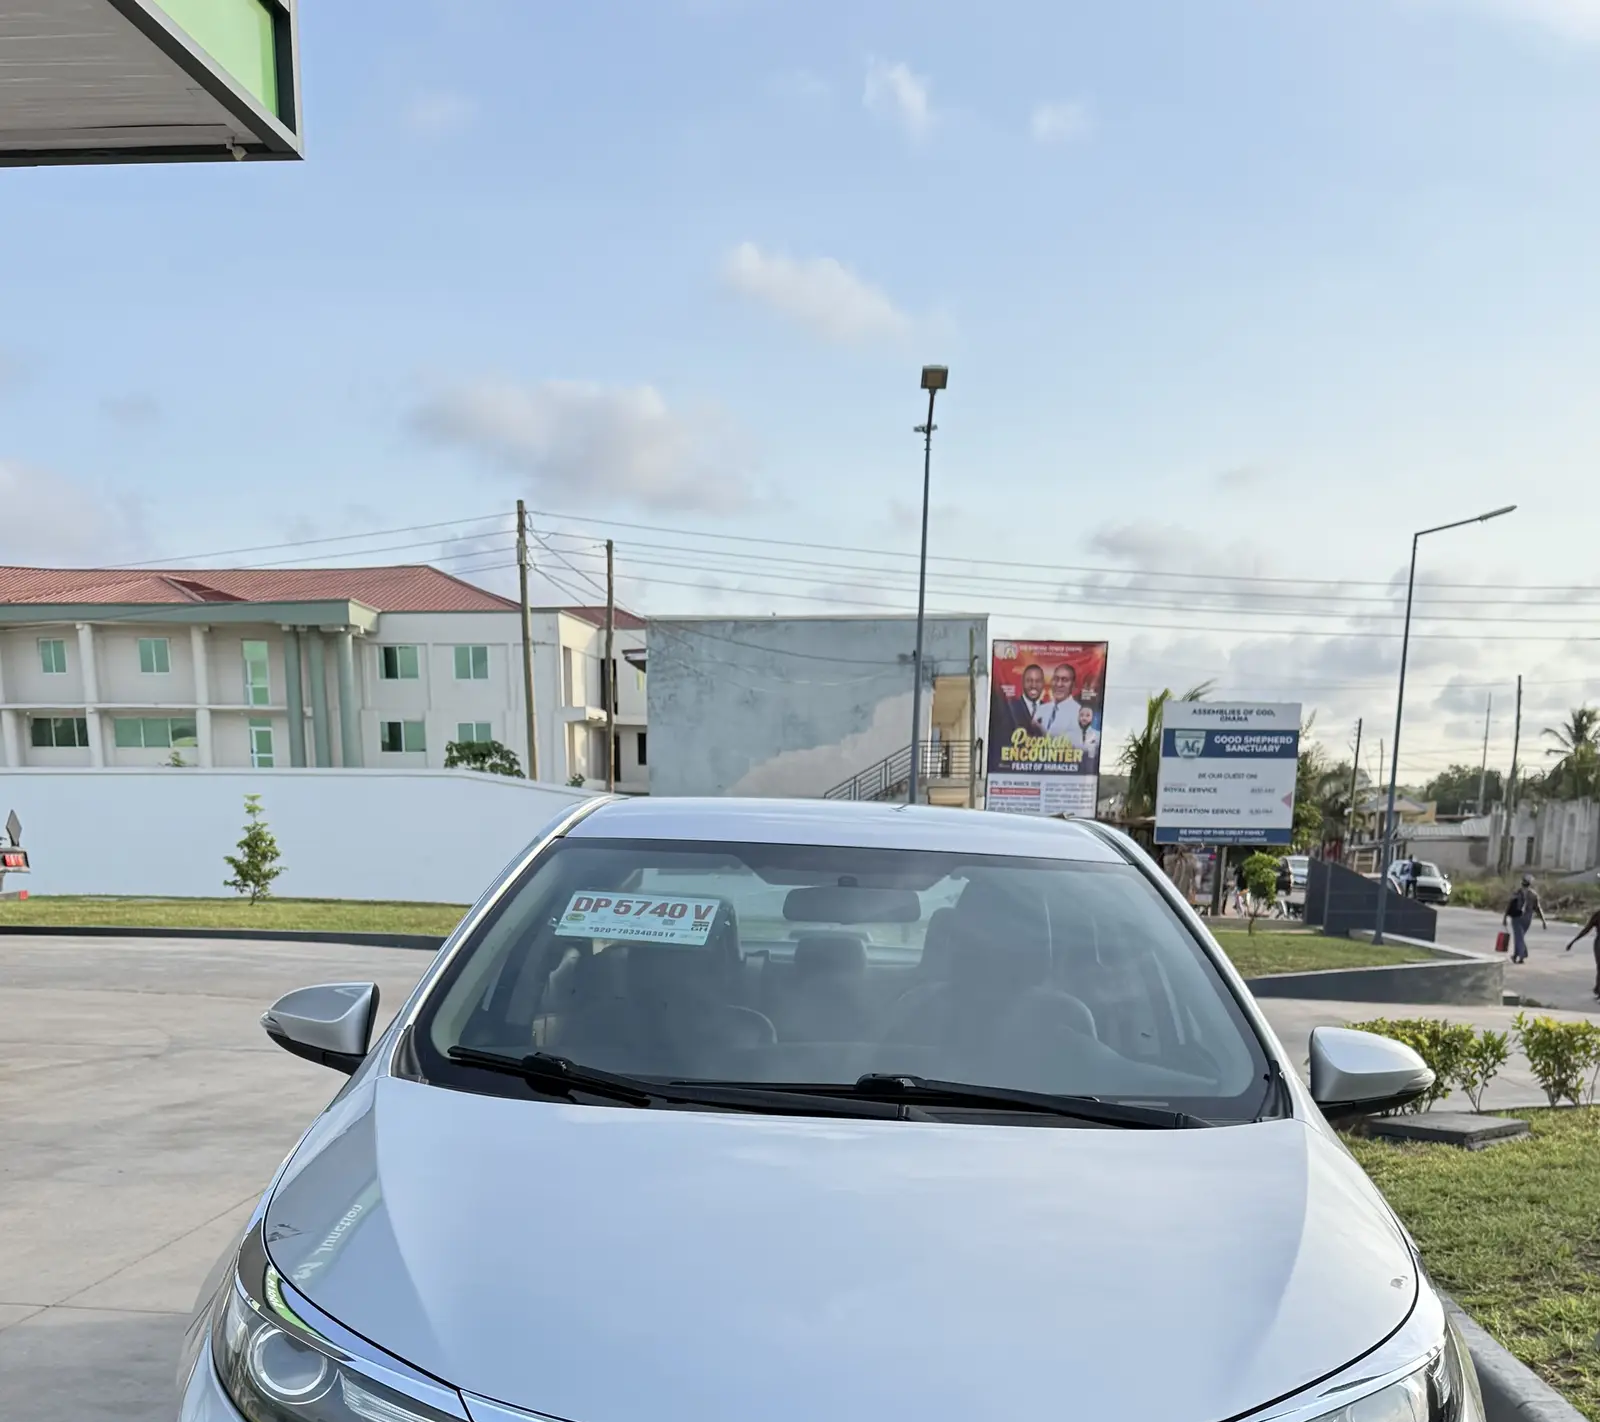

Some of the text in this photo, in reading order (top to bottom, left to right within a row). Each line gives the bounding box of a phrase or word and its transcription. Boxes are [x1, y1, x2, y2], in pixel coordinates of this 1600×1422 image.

[1191, 708, 1241, 716] ASSEMBLIES
[1213, 735, 1293, 745] GOOD SHEPHERD
[1225, 744, 1282, 753] SANCTUARY
[1001, 746, 1084, 763] ENCOUNTER
[1011, 762, 1033, 771] FEAST
[1033, 762, 1043, 771] OF
[1043, 763, 1079, 772] MIRACLES
[1208, 772, 1223, 780] OUR
[1161, 807, 1210, 815] IMPARTATION
[571, 896, 714, 921] DP 5740 V
